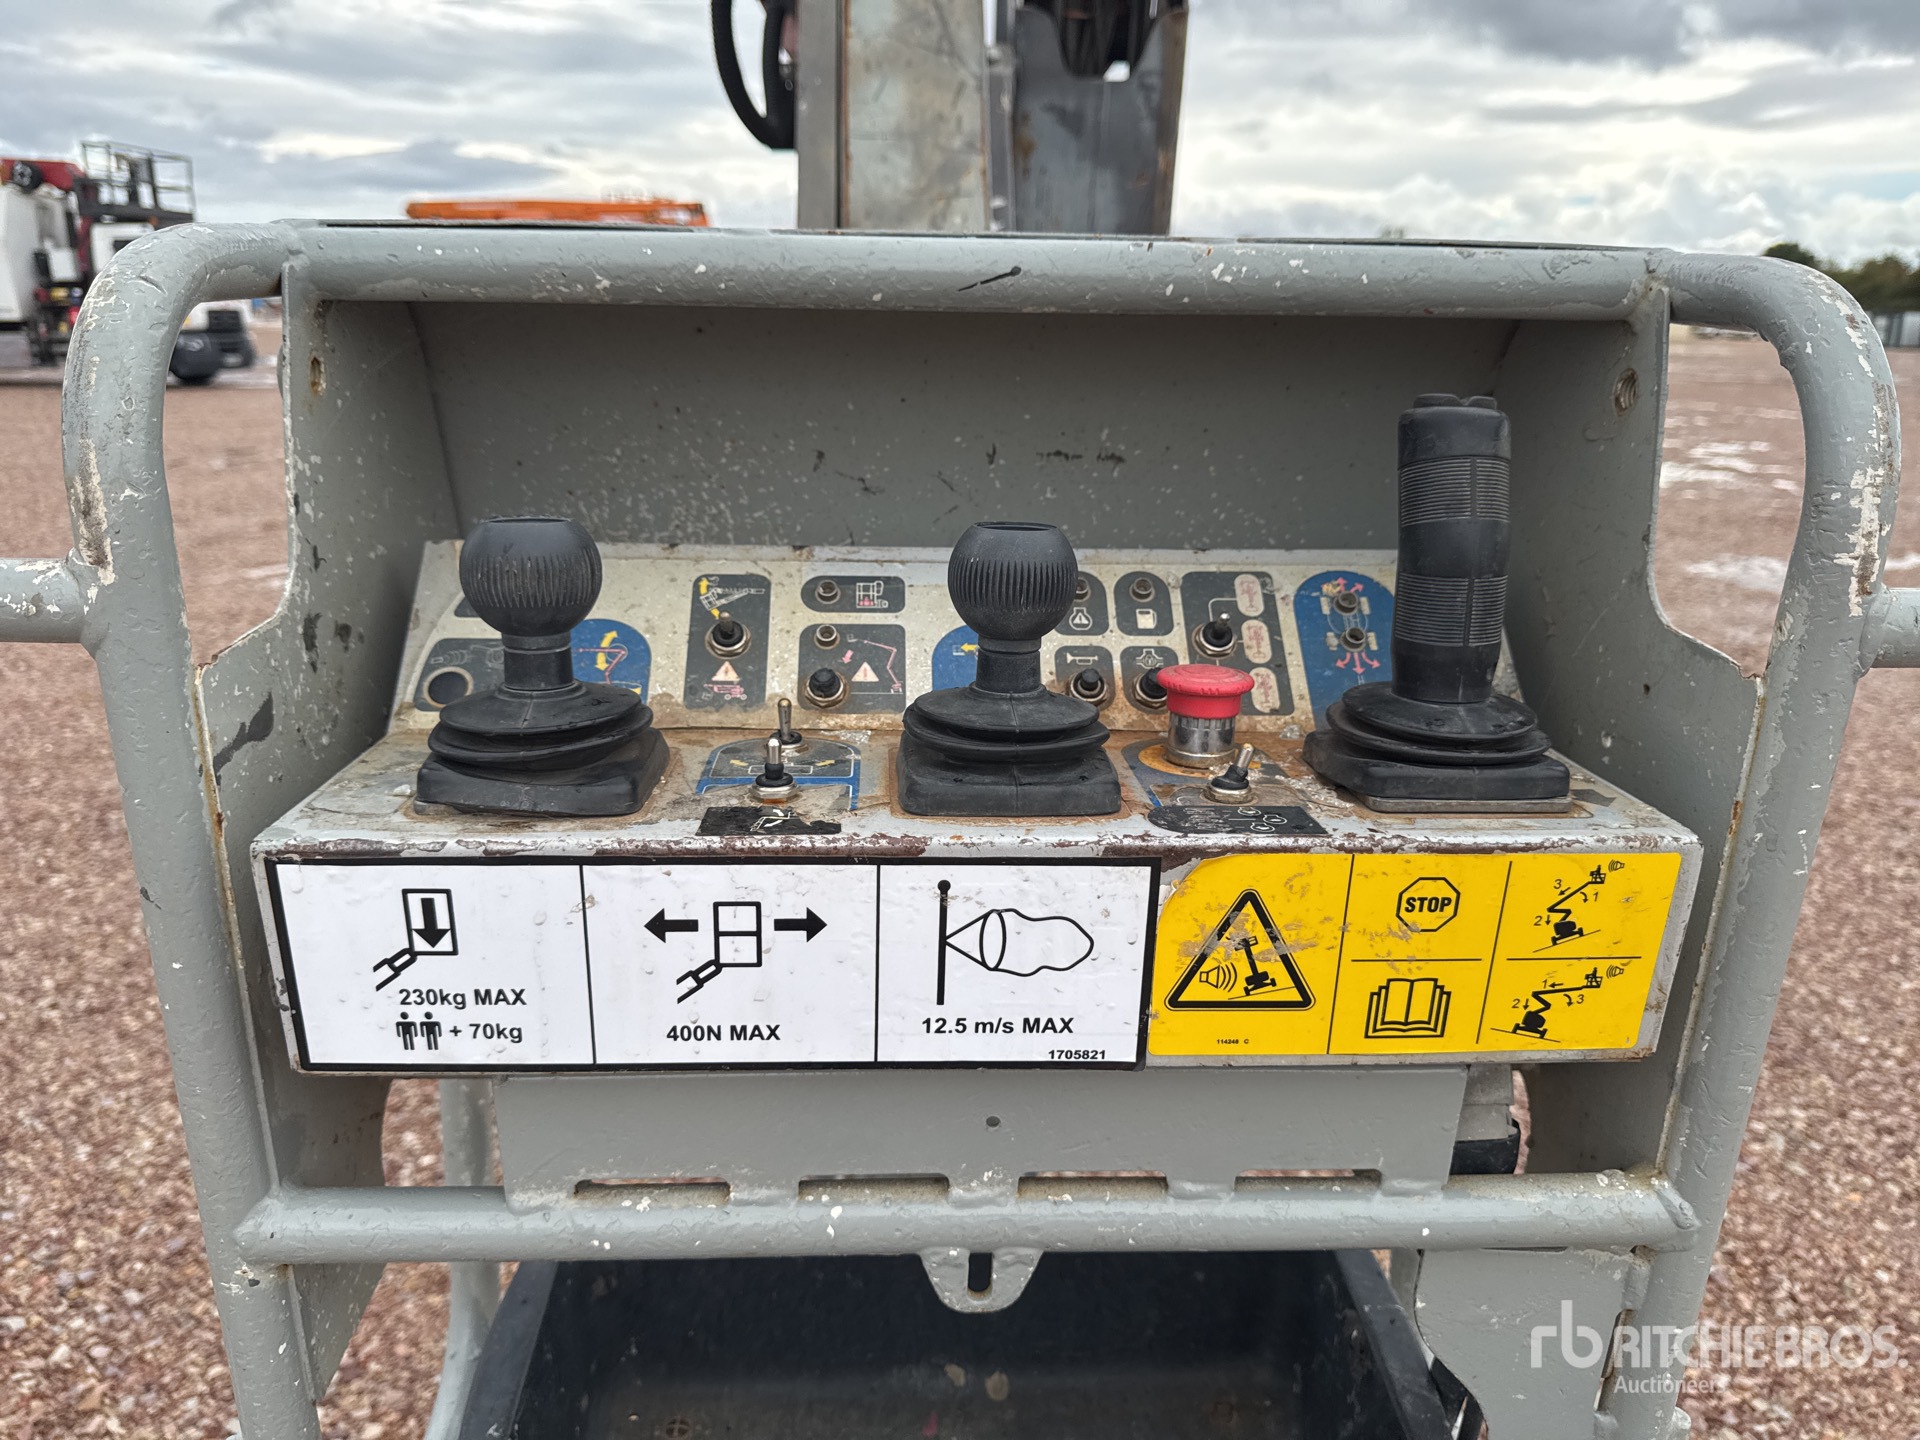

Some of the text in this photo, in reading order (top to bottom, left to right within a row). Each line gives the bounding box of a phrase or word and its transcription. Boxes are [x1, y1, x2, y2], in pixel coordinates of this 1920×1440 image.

[1553, 879, 1562, 889] 3
[1593, 892, 1598, 902] 1
[1404, 896, 1452, 913] STOP
[1533, 915, 1543, 926] 2
[1542, 979, 1548, 989] 1
[399, 988, 527, 1010] 230kg MAX
[1511, 998, 1520, 1009] 2
[1576, 994, 1585, 1004] 3
[921, 1017, 1075, 1034] 12.5 m/s MAX
[469, 1023, 523, 1043] 70kg
[666, 1024, 781, 1041] 400N MAX
[1047, 1049, 1107, 1060] 1705821
